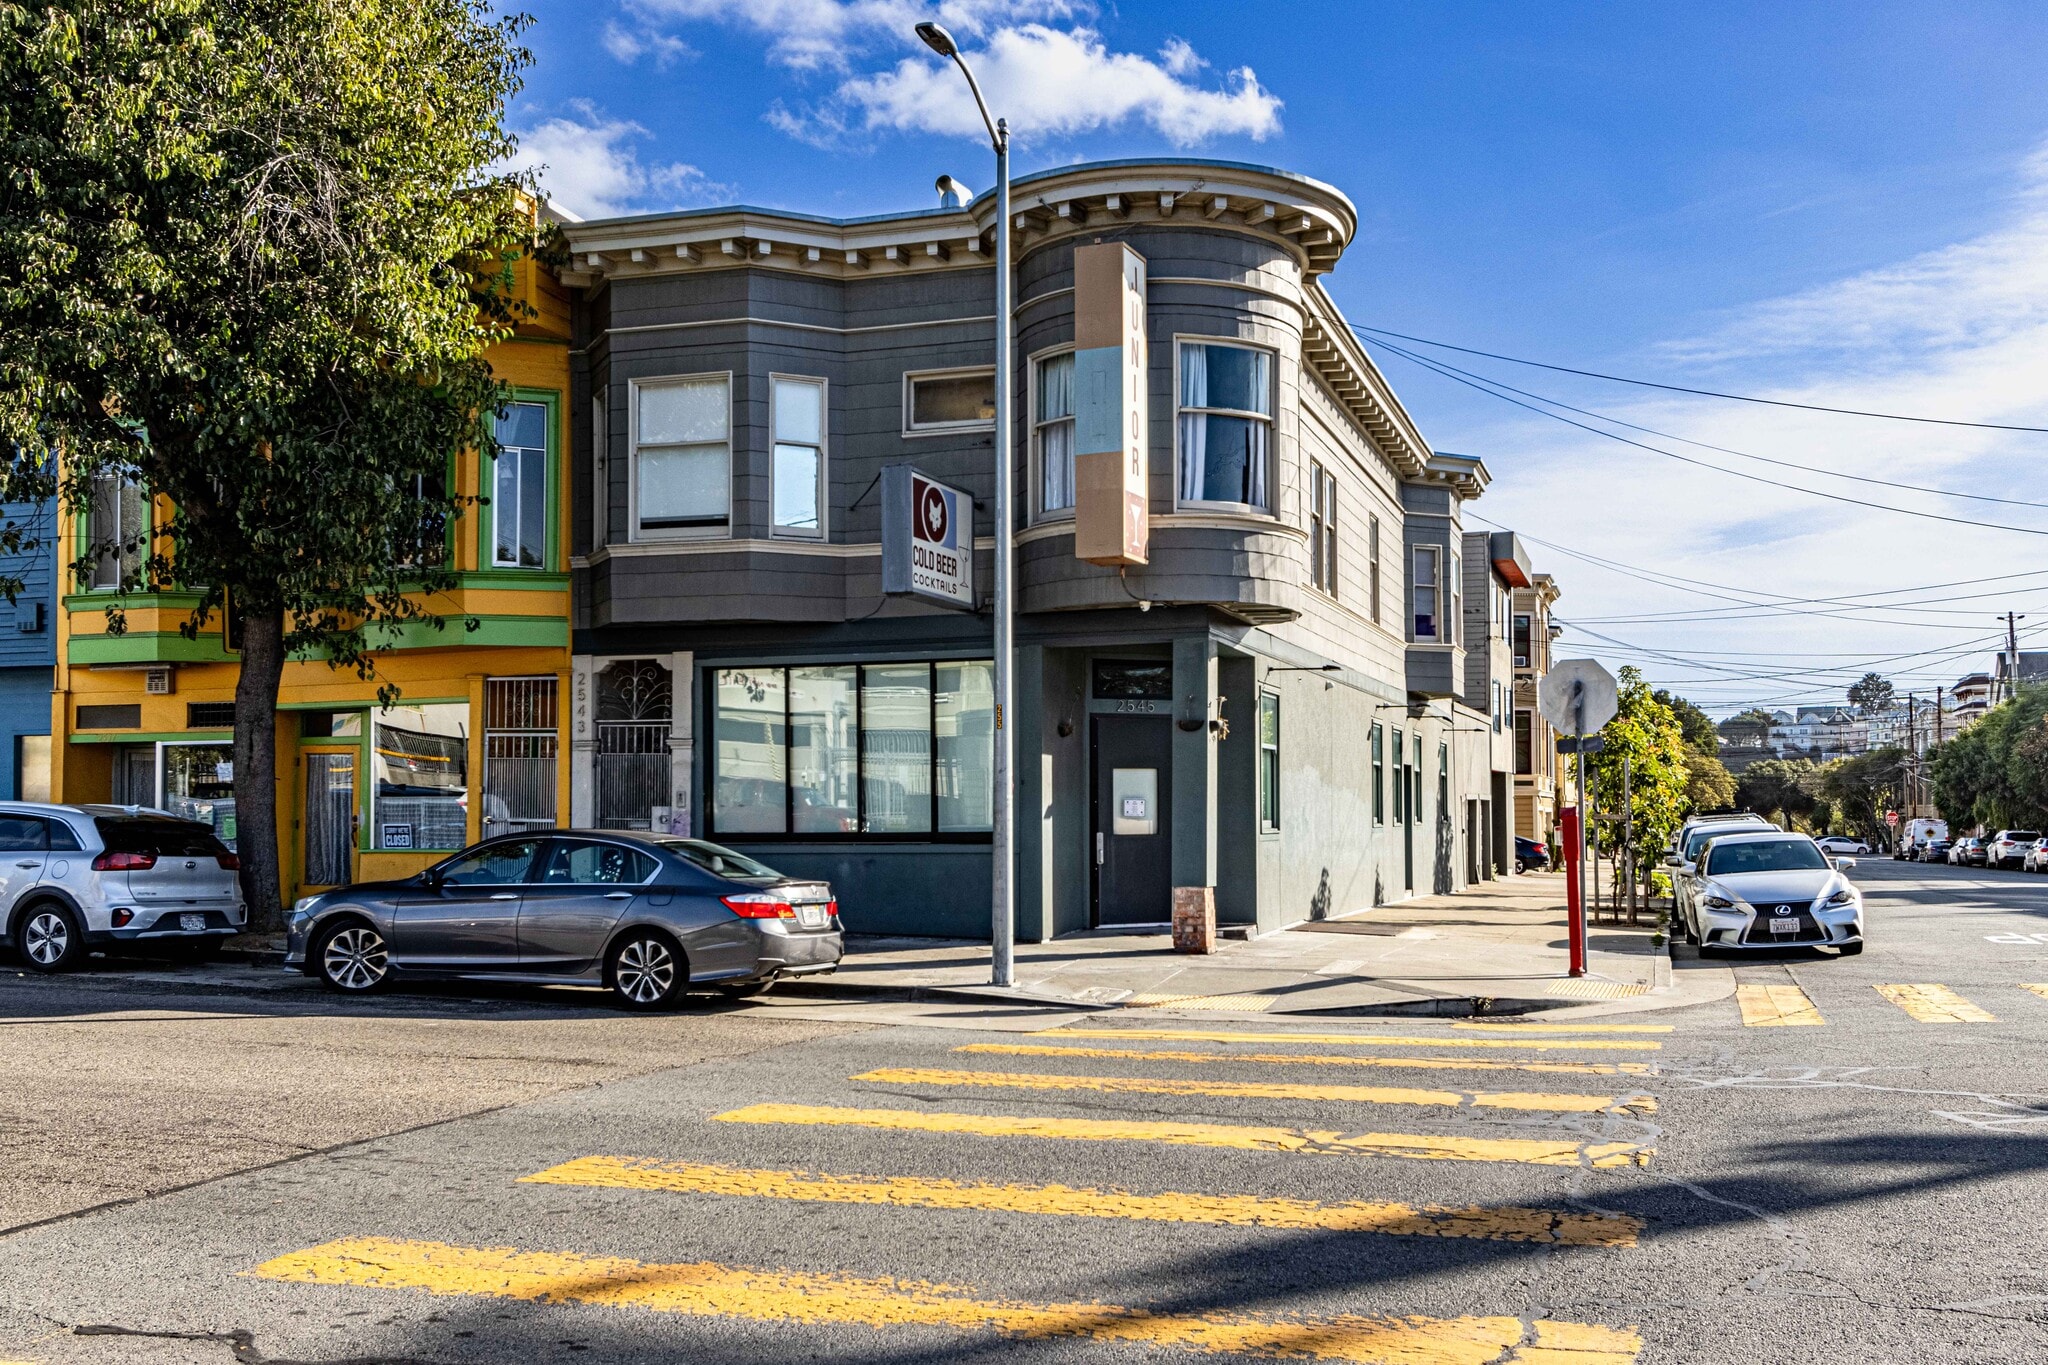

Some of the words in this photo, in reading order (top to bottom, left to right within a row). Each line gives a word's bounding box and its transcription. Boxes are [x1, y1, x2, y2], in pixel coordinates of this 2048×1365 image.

[1130, 266, 1140, 477] JUNIOR
[912, 545, 935, 571] COLD
[936, 552, 958, 578] BEER
[912, 572, 958, 595] COCKTAILS
[577, 672, 586, 733] 2543
[1116, 699, 1156, 713] 2545
[385, 834, 410, 846] CLOSED
